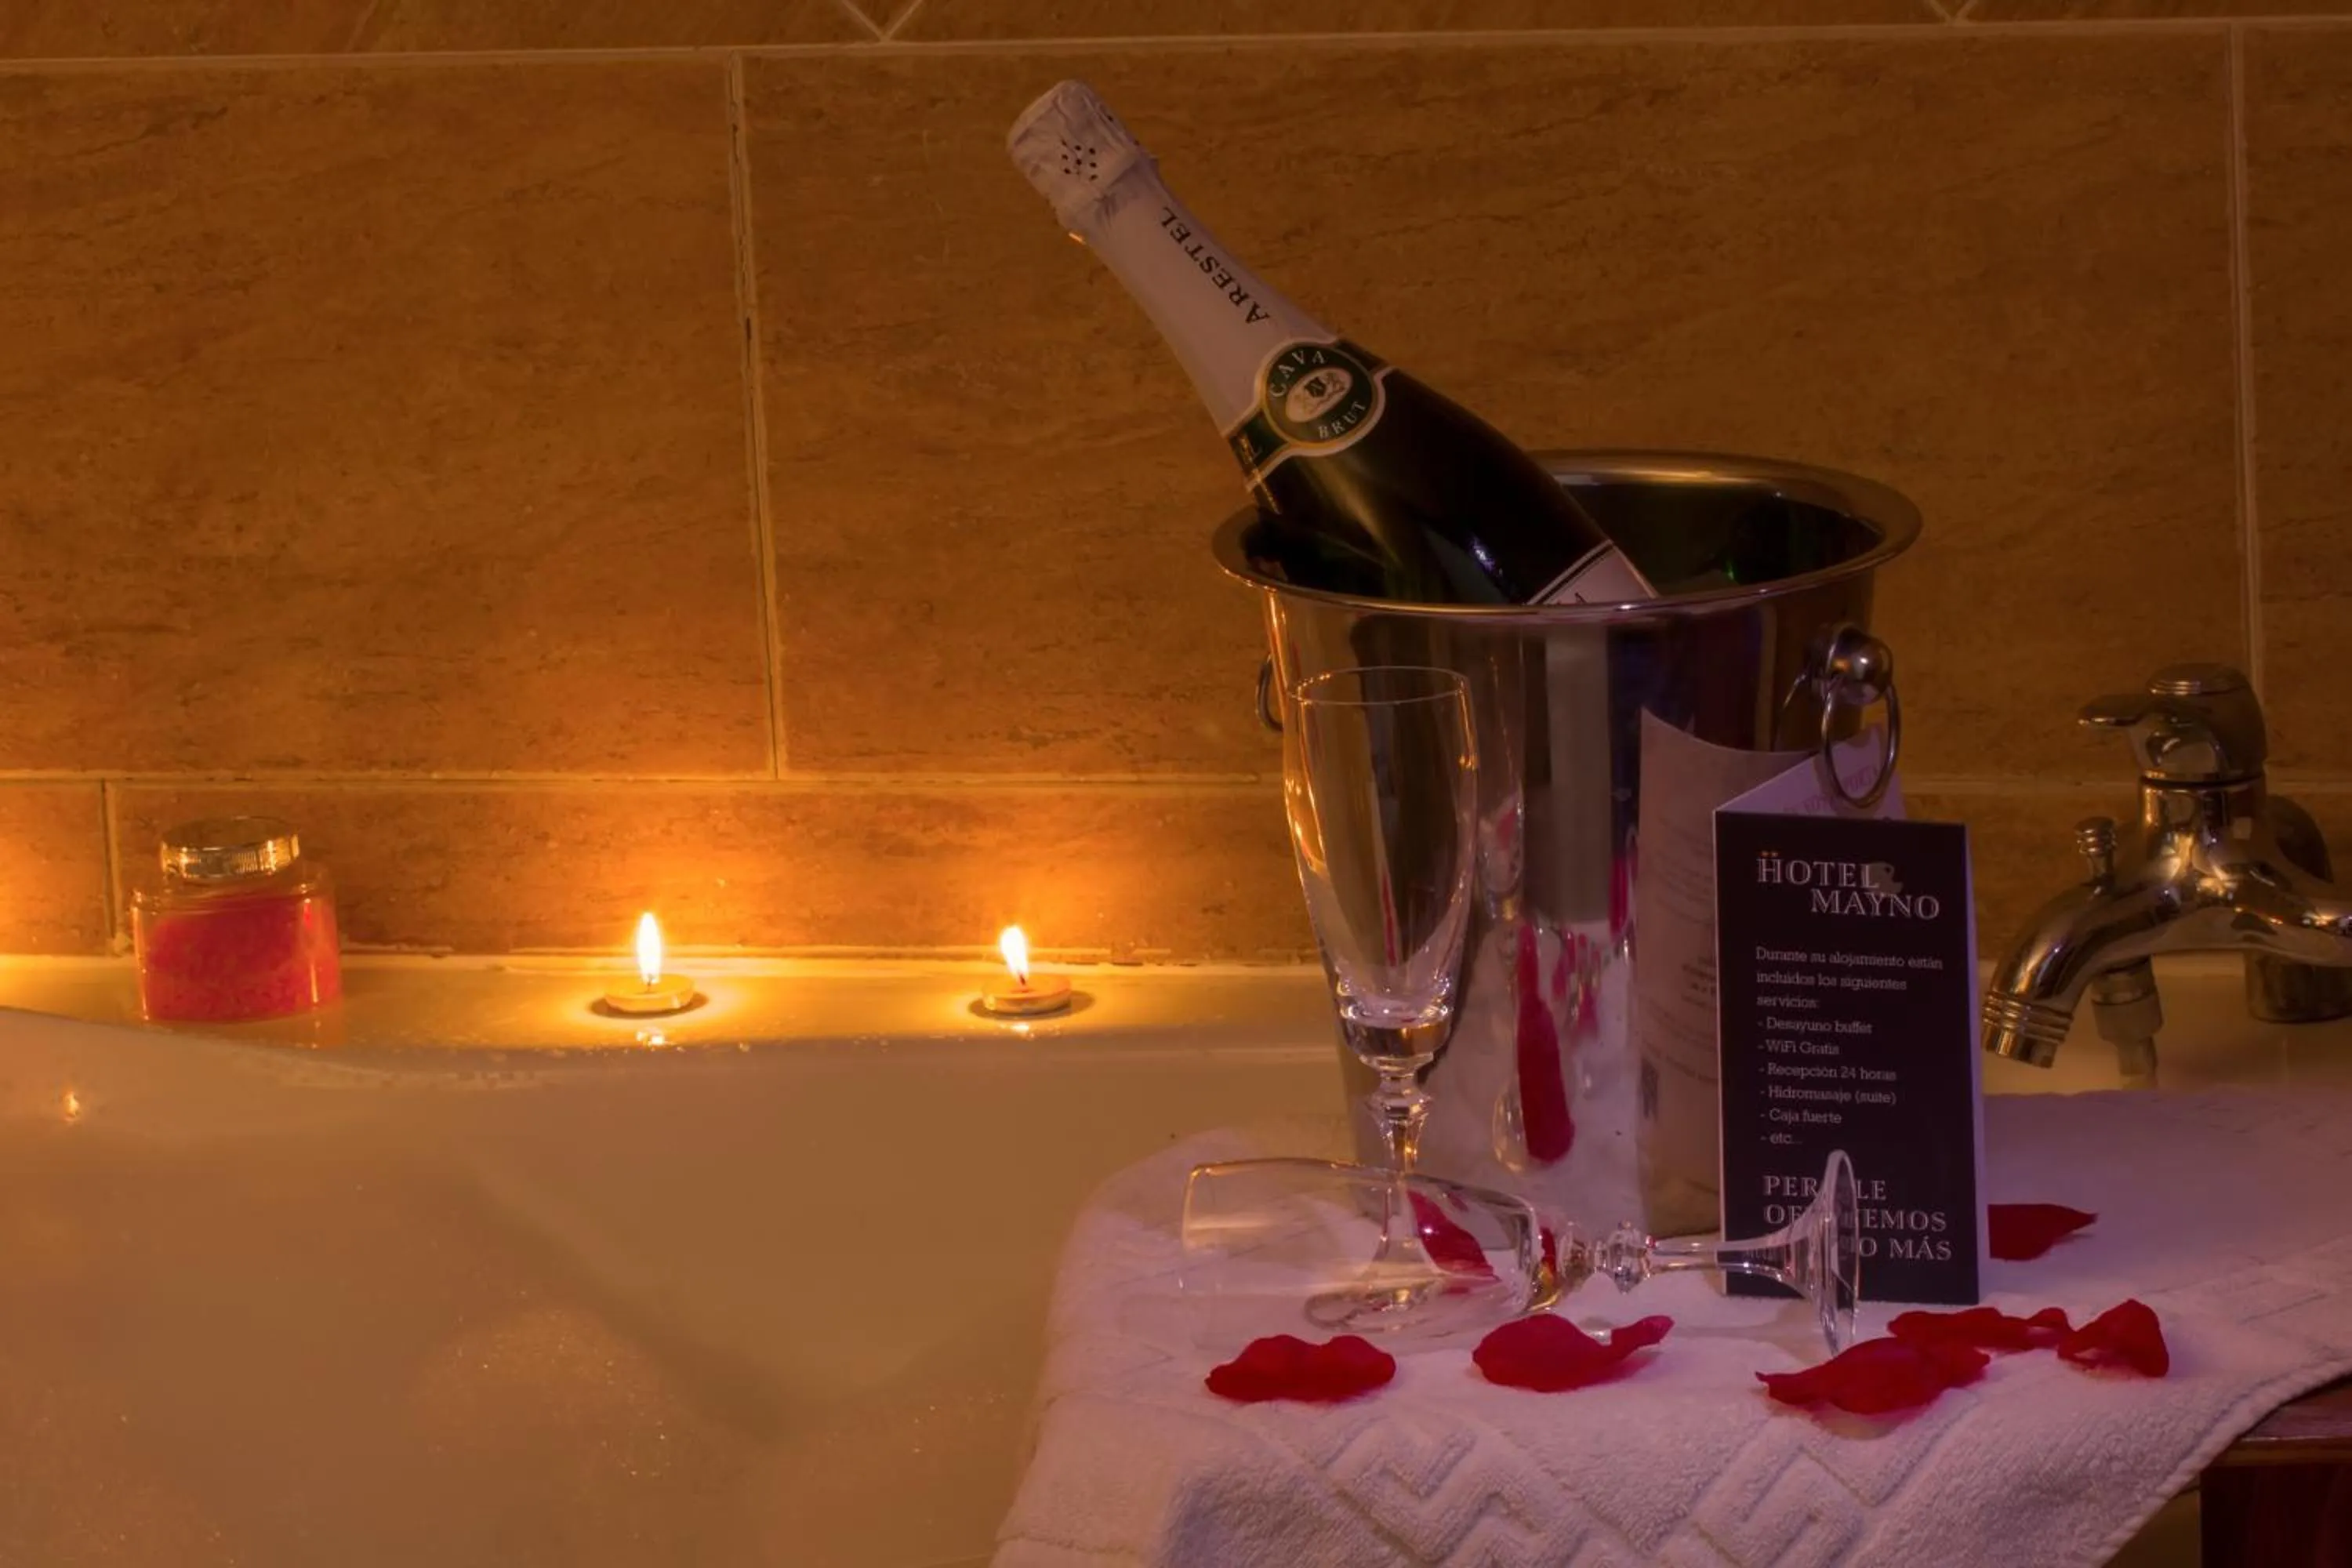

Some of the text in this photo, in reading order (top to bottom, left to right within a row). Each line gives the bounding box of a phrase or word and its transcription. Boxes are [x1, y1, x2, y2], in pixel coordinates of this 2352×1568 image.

[1160, 206, 1271, 324] ARESTEL
[1269, 350, 1327, 397] CAVA
[1319, 401, 1367, 440] BRUT
[1756, 858, 1880, 888] HOTEL
[1810, 888, 1940, 920] MAYNO
[1756, 946, 1944, 971] Durante su alojamiento están
[1756, 971, 1907, 991] incluidos los siguientes
[1766, 1016, 1832, 1034] Desayuno
[1835, 1020, 1873, 1034] buffet
[1766, 1039, 1797, 1054] WiFi
[1799, 1041, 1840, 1055] Gratis
[1767, 1062, 1837, 1080] Recepción
[1840, 1065, 1857, 1079] 24
[1859, 1066, 1897, 1081] horas
[1768, 1085, 1852, 1104] Hidromasaje
[1854, 1090, 1897, 1105] (suite)
[1769, 1108, 1799, 1125] Caja
[1802, 1109, 1843, 1124] fuerte
[1762, 1174, 1887, 1200] PER LE
[1889, 1234, 1952, 1261] MÁS
